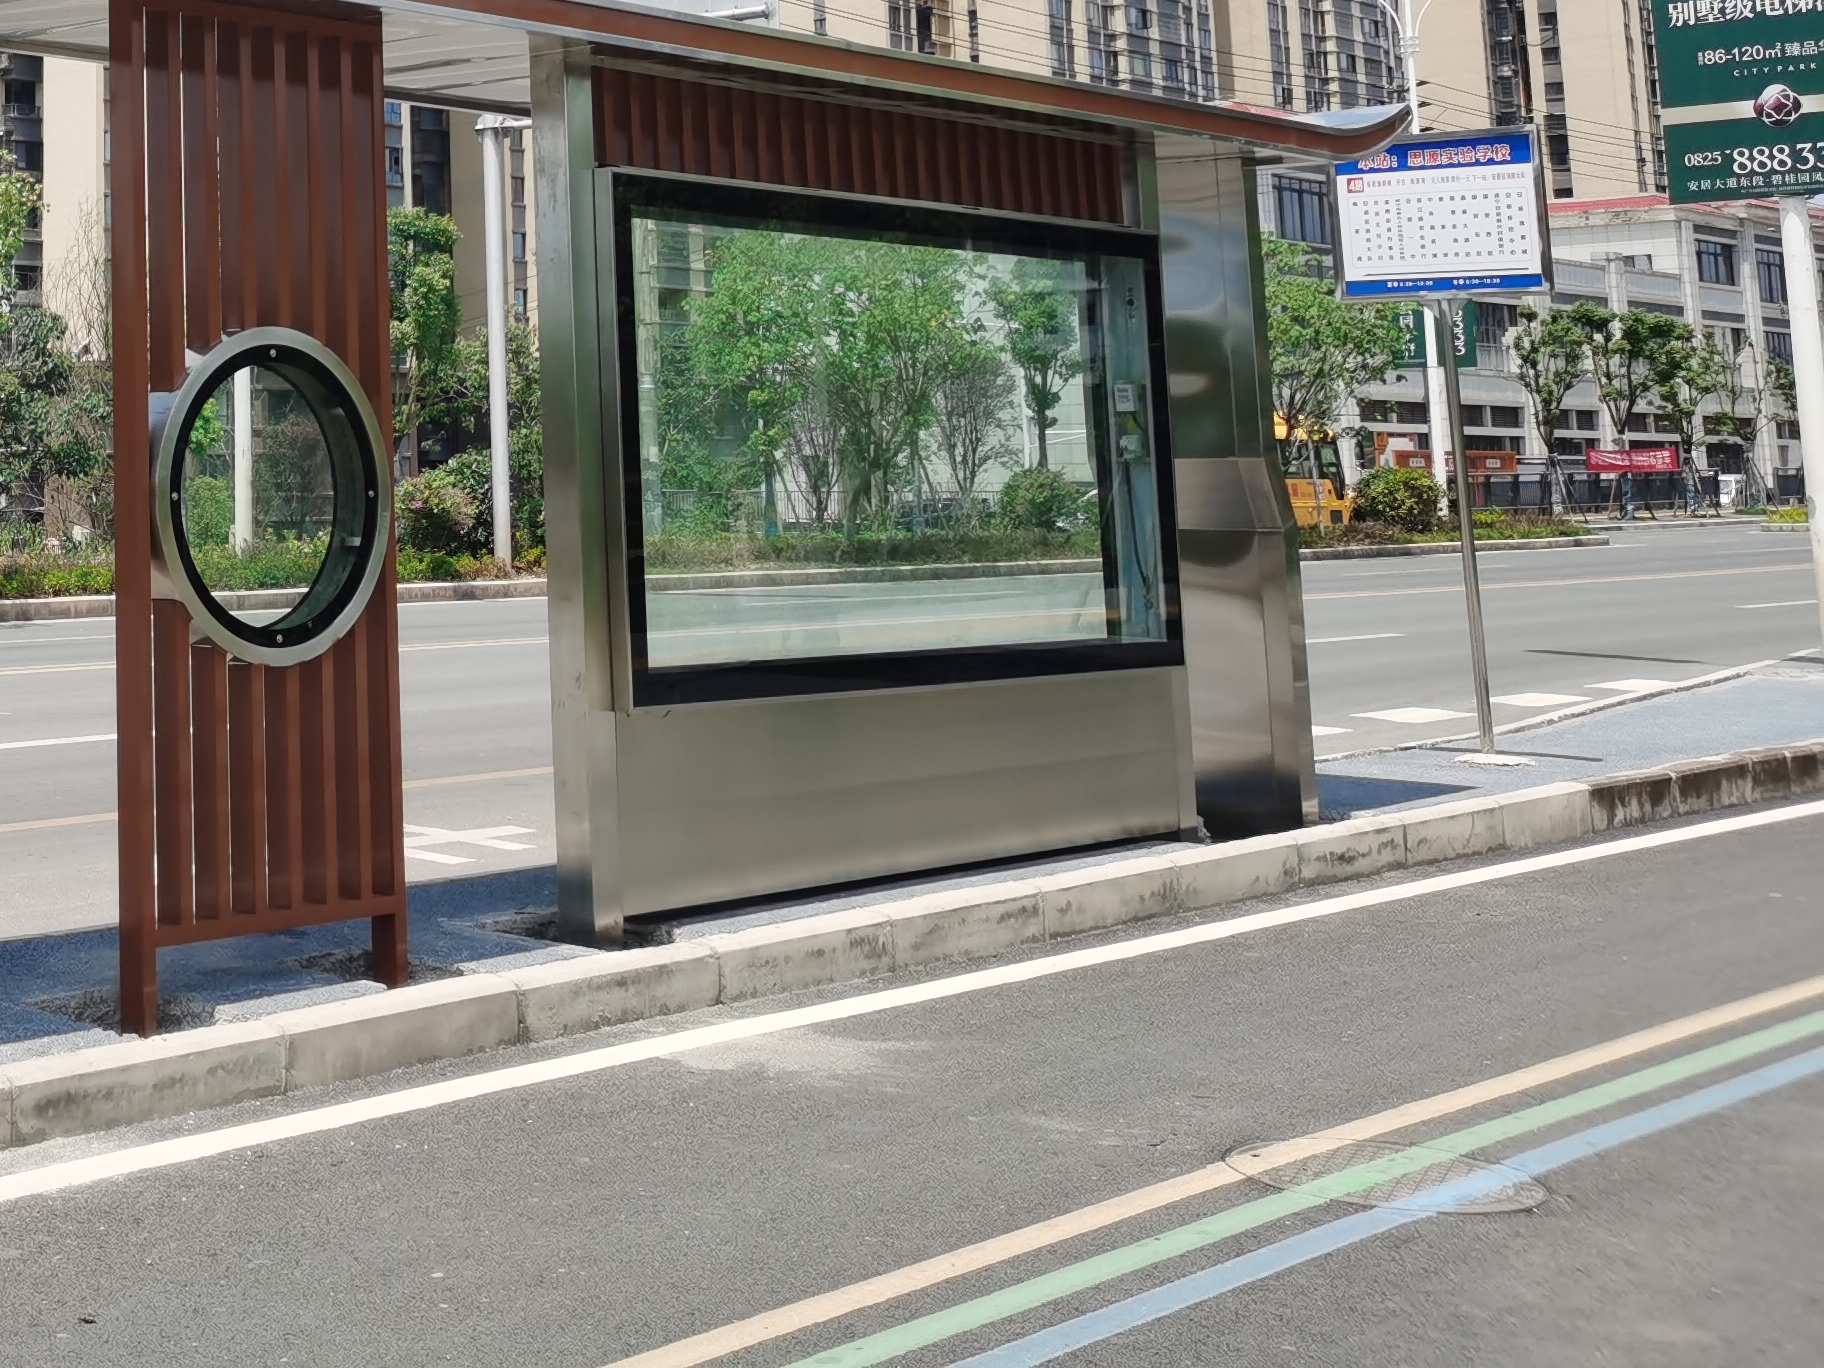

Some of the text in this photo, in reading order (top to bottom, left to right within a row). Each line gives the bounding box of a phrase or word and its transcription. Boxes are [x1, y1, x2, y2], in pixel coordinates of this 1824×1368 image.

[1733, 62, 1817, 77] CITY PARK
[1407, 143, 1511, 167] 思源实验学校
